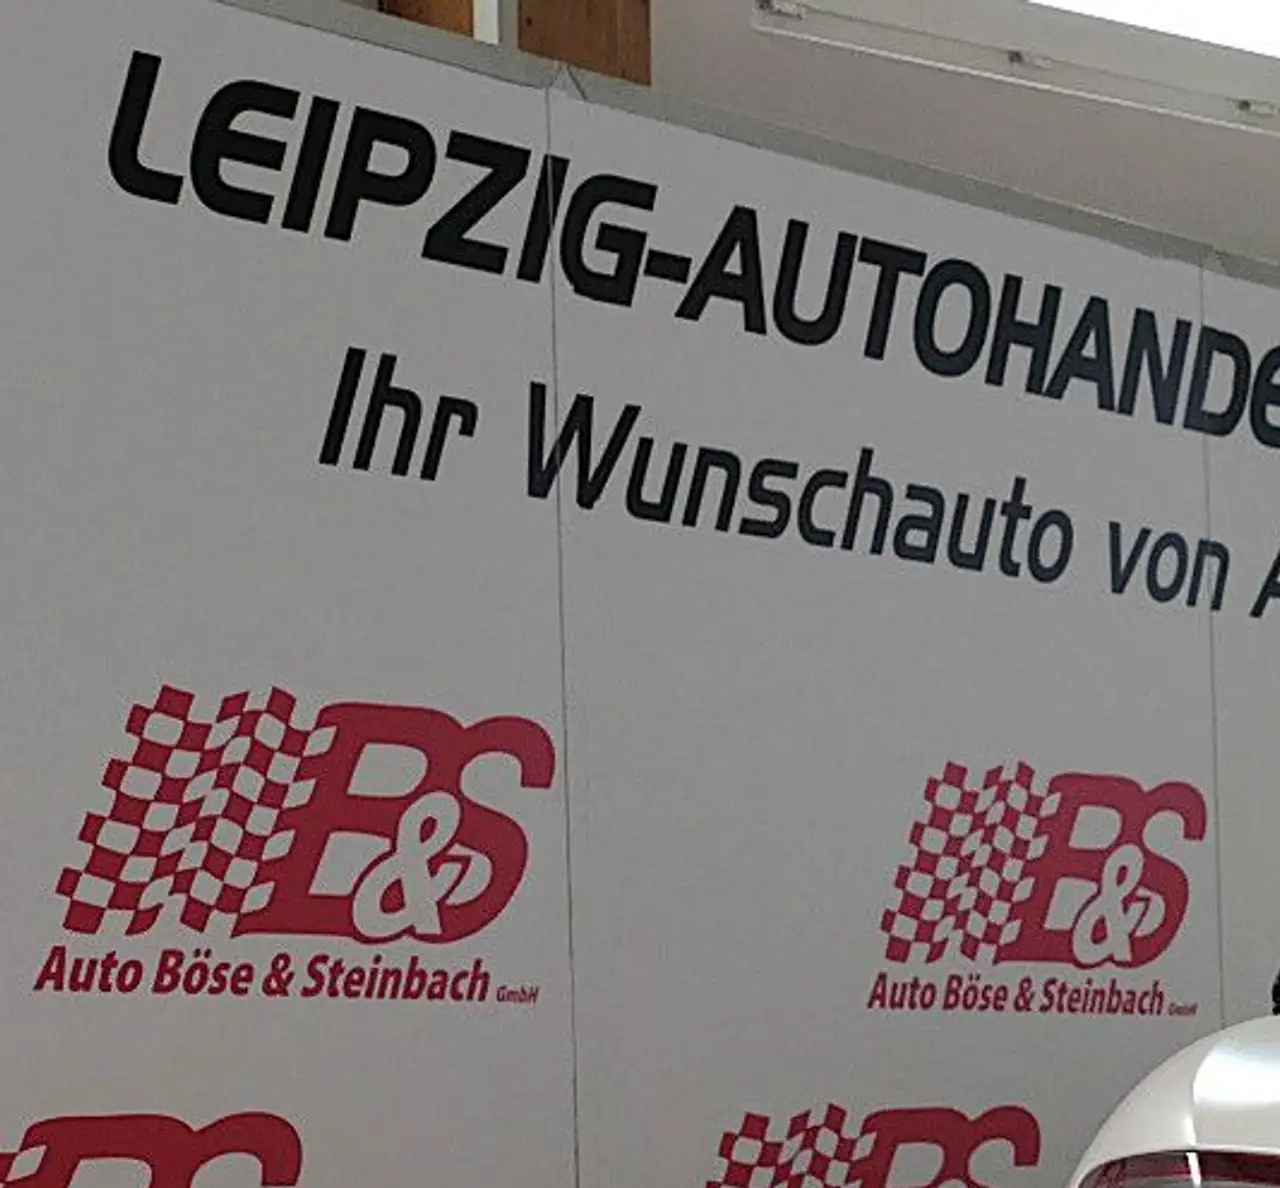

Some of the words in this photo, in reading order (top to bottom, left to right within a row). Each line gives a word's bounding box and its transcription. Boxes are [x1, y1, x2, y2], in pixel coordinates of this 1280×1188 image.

[319, 346, 479, 482] Ihr
[527, 381, 1074, 583] Wunschauto
[1108, 521, 1231, 612] von
[33, 945, 143, 993] Auto
[152, 948, 255, 999] Böse
[261, 952, 296, 998] &
[300, 953, 492, 1002] Steinbach
[496, 984, 540, 1004] GmbH
[867, 972, 937, 1011] Auto
[942, 974, 1010, 1013] Böse
[1012, 976, 1035, 1012] &
[1038, 977, 1165, 1017] Steinbach
